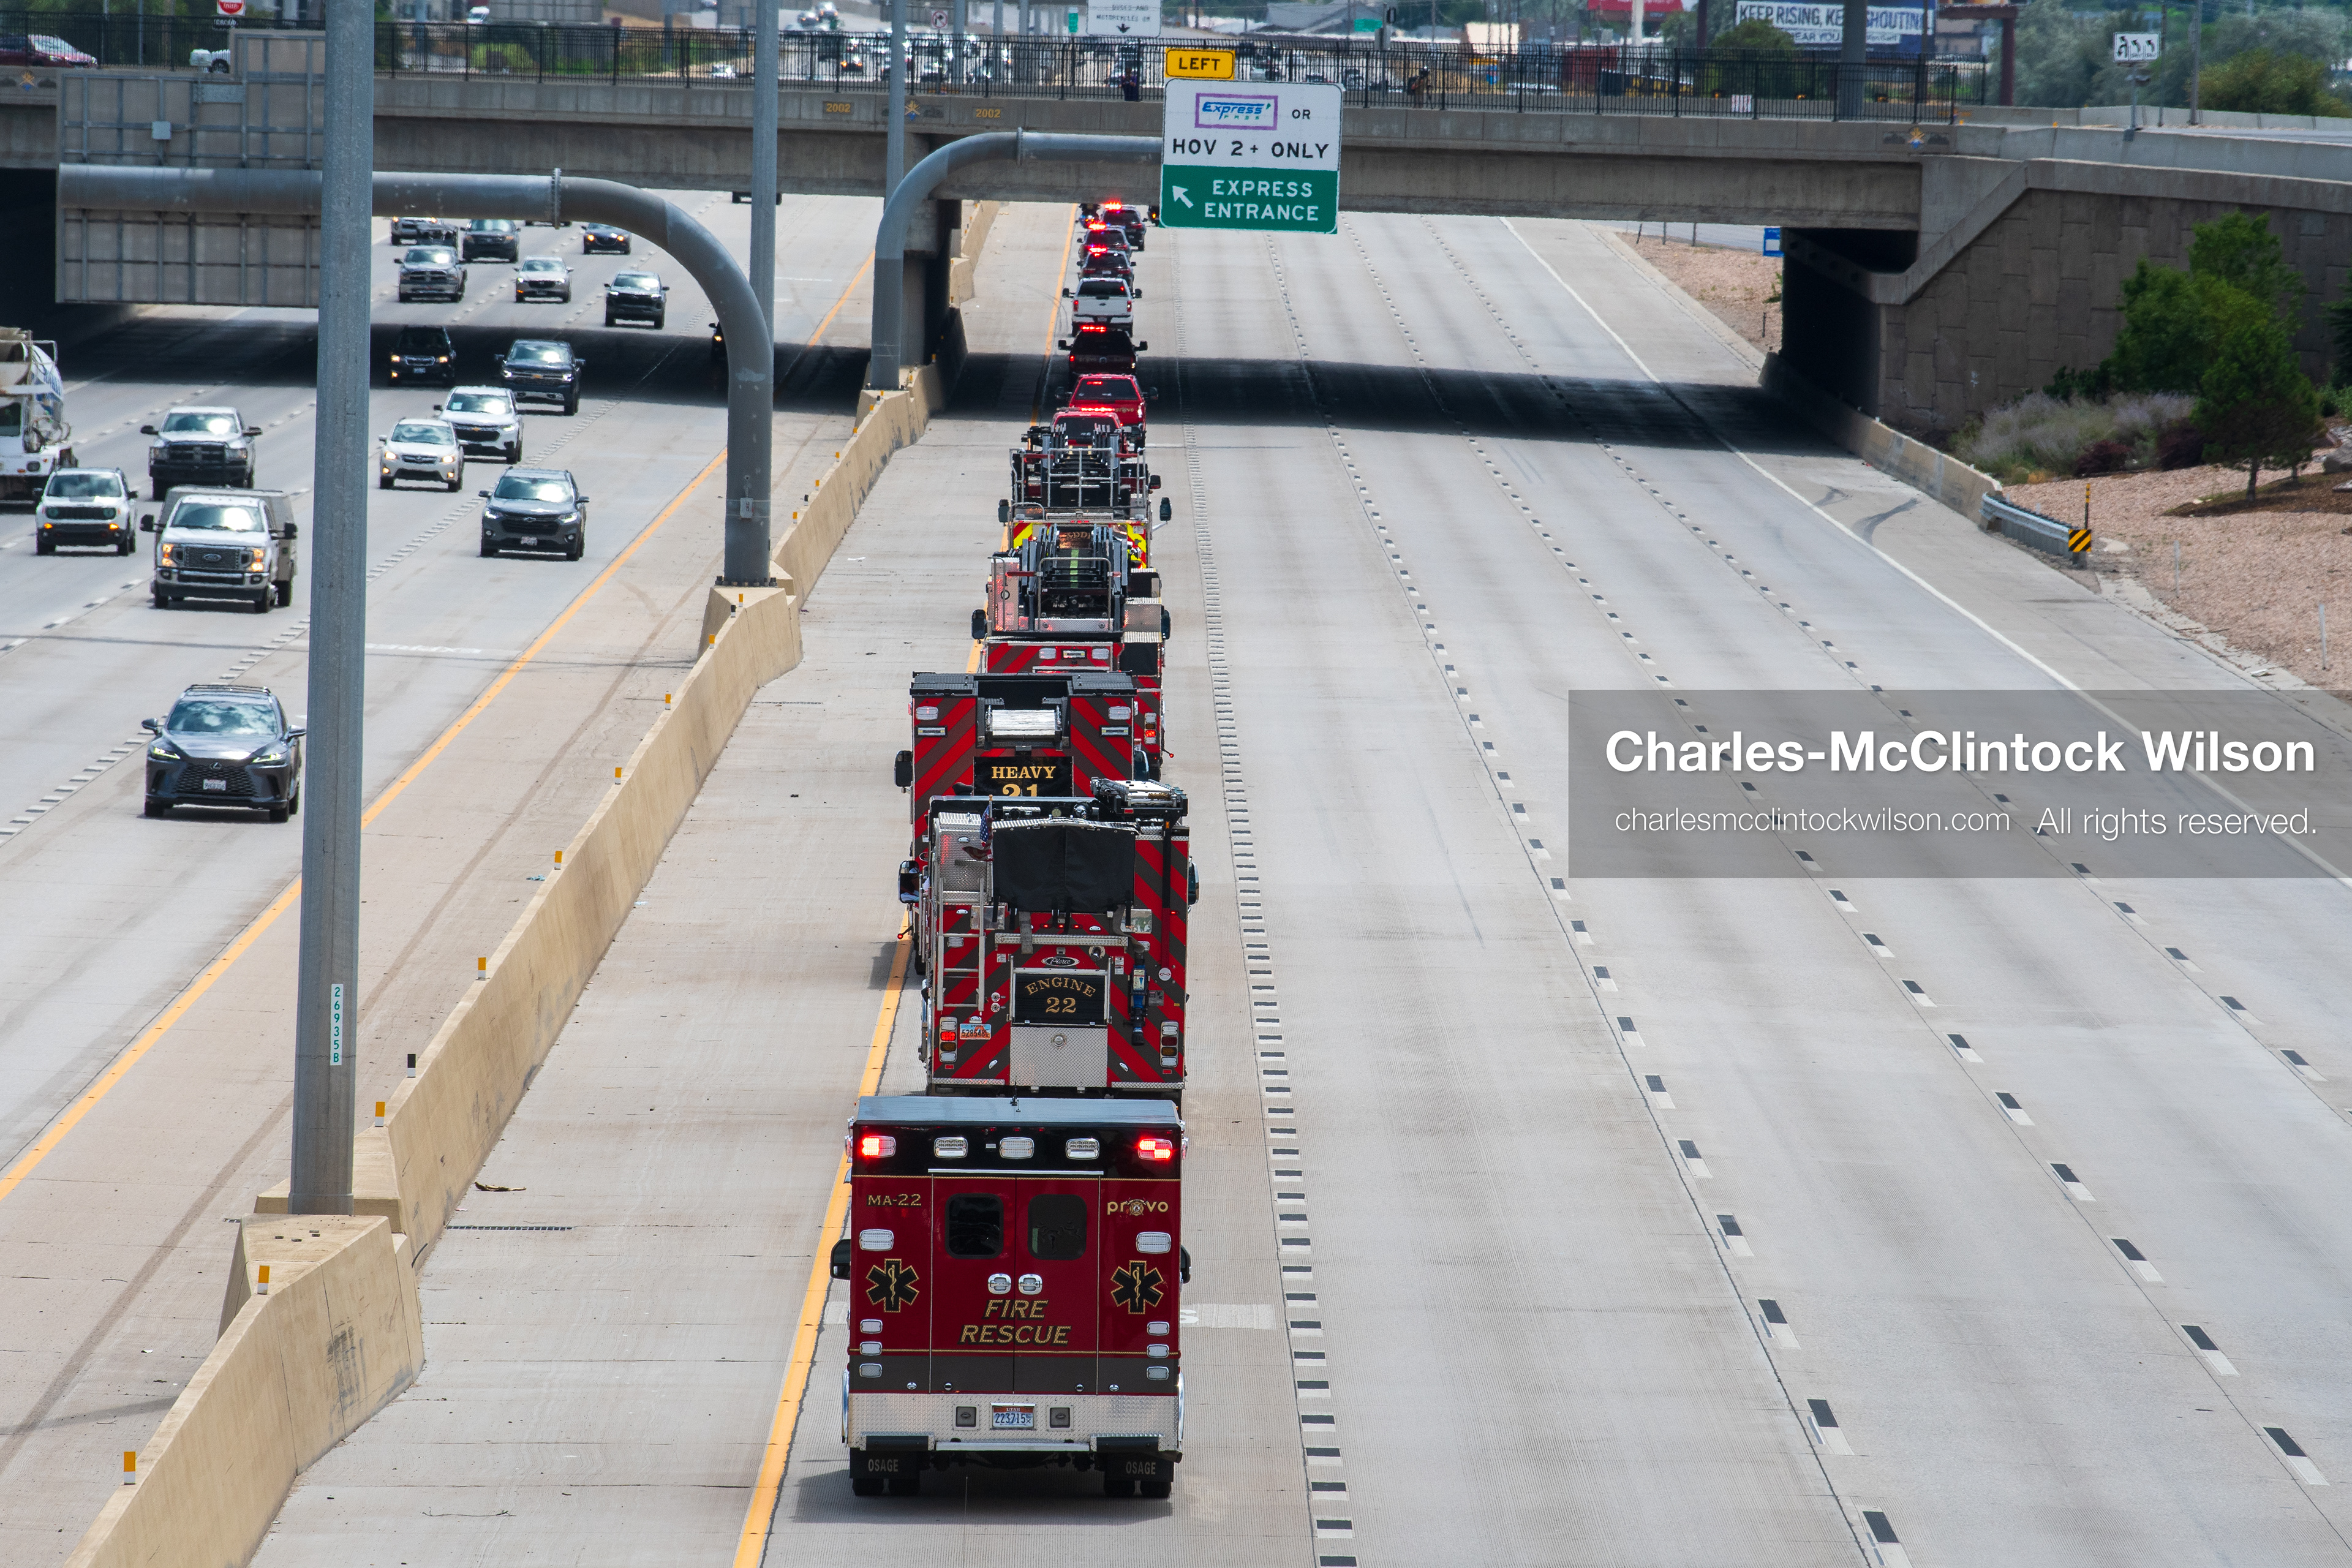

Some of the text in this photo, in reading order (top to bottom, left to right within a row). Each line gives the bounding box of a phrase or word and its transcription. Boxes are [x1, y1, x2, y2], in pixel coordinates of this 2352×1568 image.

[1777, 6, 1822, 27] RISING,
[1792, 32, 1815, 41] EAR
[1178, 58, 1221, 71] LEFT
[826, 103, 851, 113] 2002
[976, 108, 1001, 118] 2002
[1202, 102, 1311, 121] Express OR
[1173, 138, 1330, 159] HOV 2+ ONLY
[1213, 179, 1313, 198] EXPRESS
[1205, 202, 1319, 222] ENTRANCE
[991, 766, 1056, 778] HEAVY
[1002, 783, 1038, 797] 21
[1024, 977, 1096, 998] ENGINE
[1045, 997, 1077, 1014] 22
[867, 1193, 922, 1206] MA-22
[983, 1299, 1049, 1319] FIRE
[959, 1324, 1071, 1346] RESCUE
[995, 1413, 1026, 1423] 223715
[868, 1459, 899, 1472] OSAGE
[1126, 1461, 1156, 1475] OSAGE
